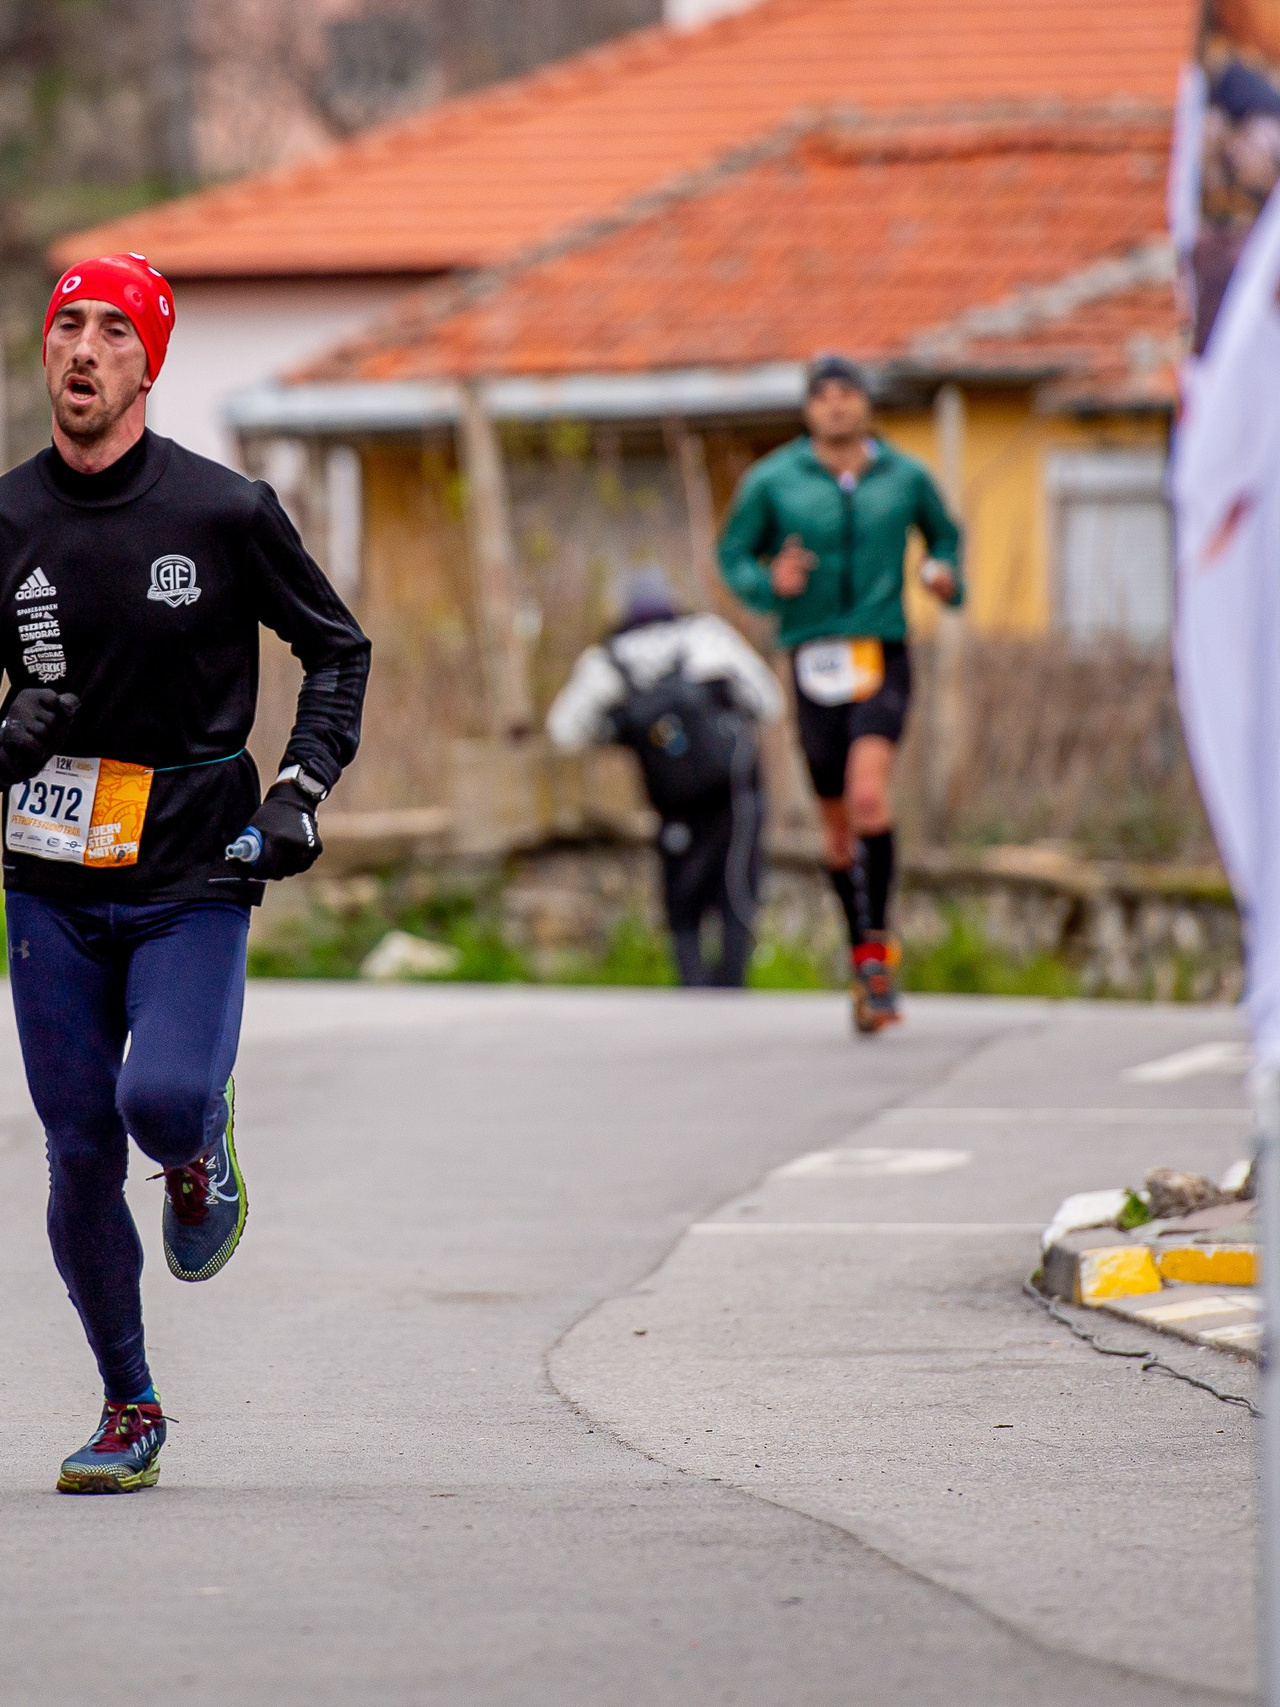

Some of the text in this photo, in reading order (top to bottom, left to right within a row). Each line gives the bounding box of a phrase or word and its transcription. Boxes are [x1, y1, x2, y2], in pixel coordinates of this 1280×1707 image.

[15, 586, 57, 600] adidas
[56, 757, 73, 771] 12K
[88, 834, 115, 849] STEP
